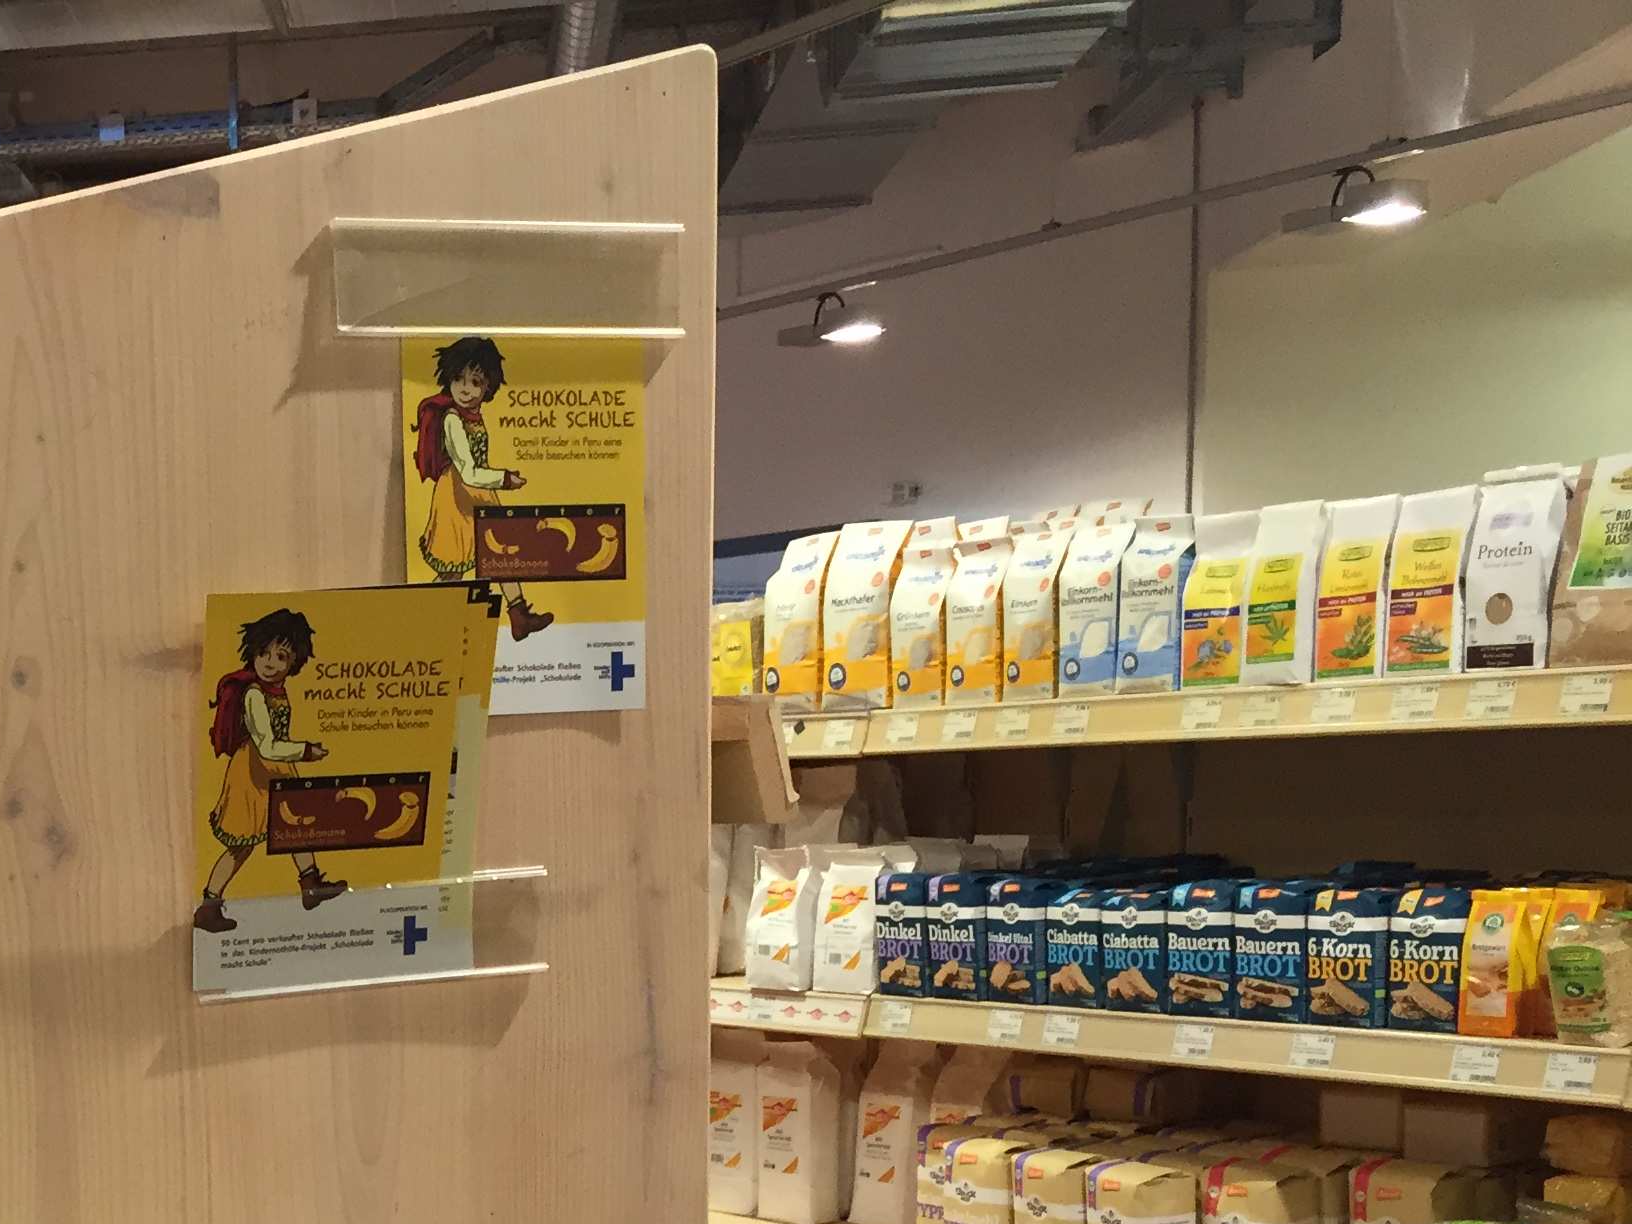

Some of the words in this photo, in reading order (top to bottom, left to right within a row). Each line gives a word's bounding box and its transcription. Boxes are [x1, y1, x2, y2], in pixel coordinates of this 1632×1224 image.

[508, 389, 626, 407] SCHOKOLADE
[499, 410, 557, 428] macht
[566, 411, 635, 428] SCHULE
[1478, 541, 1533, 561] Protein
[315, 660, 443, 681] SCHOKOLADE
[304, 682, 366, 700] macht
[376, 681, 450, 699] SCHULE
[877, 921, 922, 939] Dinkel
[929, 924, 975, 942] Dinkel
[1047, 928, 1098, 945] Ciabatta
[879, 940, 922, 959] BROT
[1103, 932, 1159, 949] Ciabatta
[1168, 932, 1230, 951] Bauern
[1235, 935, 1301, 955] Bauern
[1308, 936, 1372, 959] 6-Korn
[1390, 938, 1459, 961] 6-Korn
[930, 942, 975, 962] BROT
[988, 944, 1033, 964] BROT
[1048, 944, 1098, 966] BROT
[1104, 949, 1159, 970] BROT
[1169, 951, 1230, 973] BROT
[1236, 955, 1301, 978] BROT
[1308, 957, 1372, 982] BROT
[1390, 960, 1459, 985] BROT
